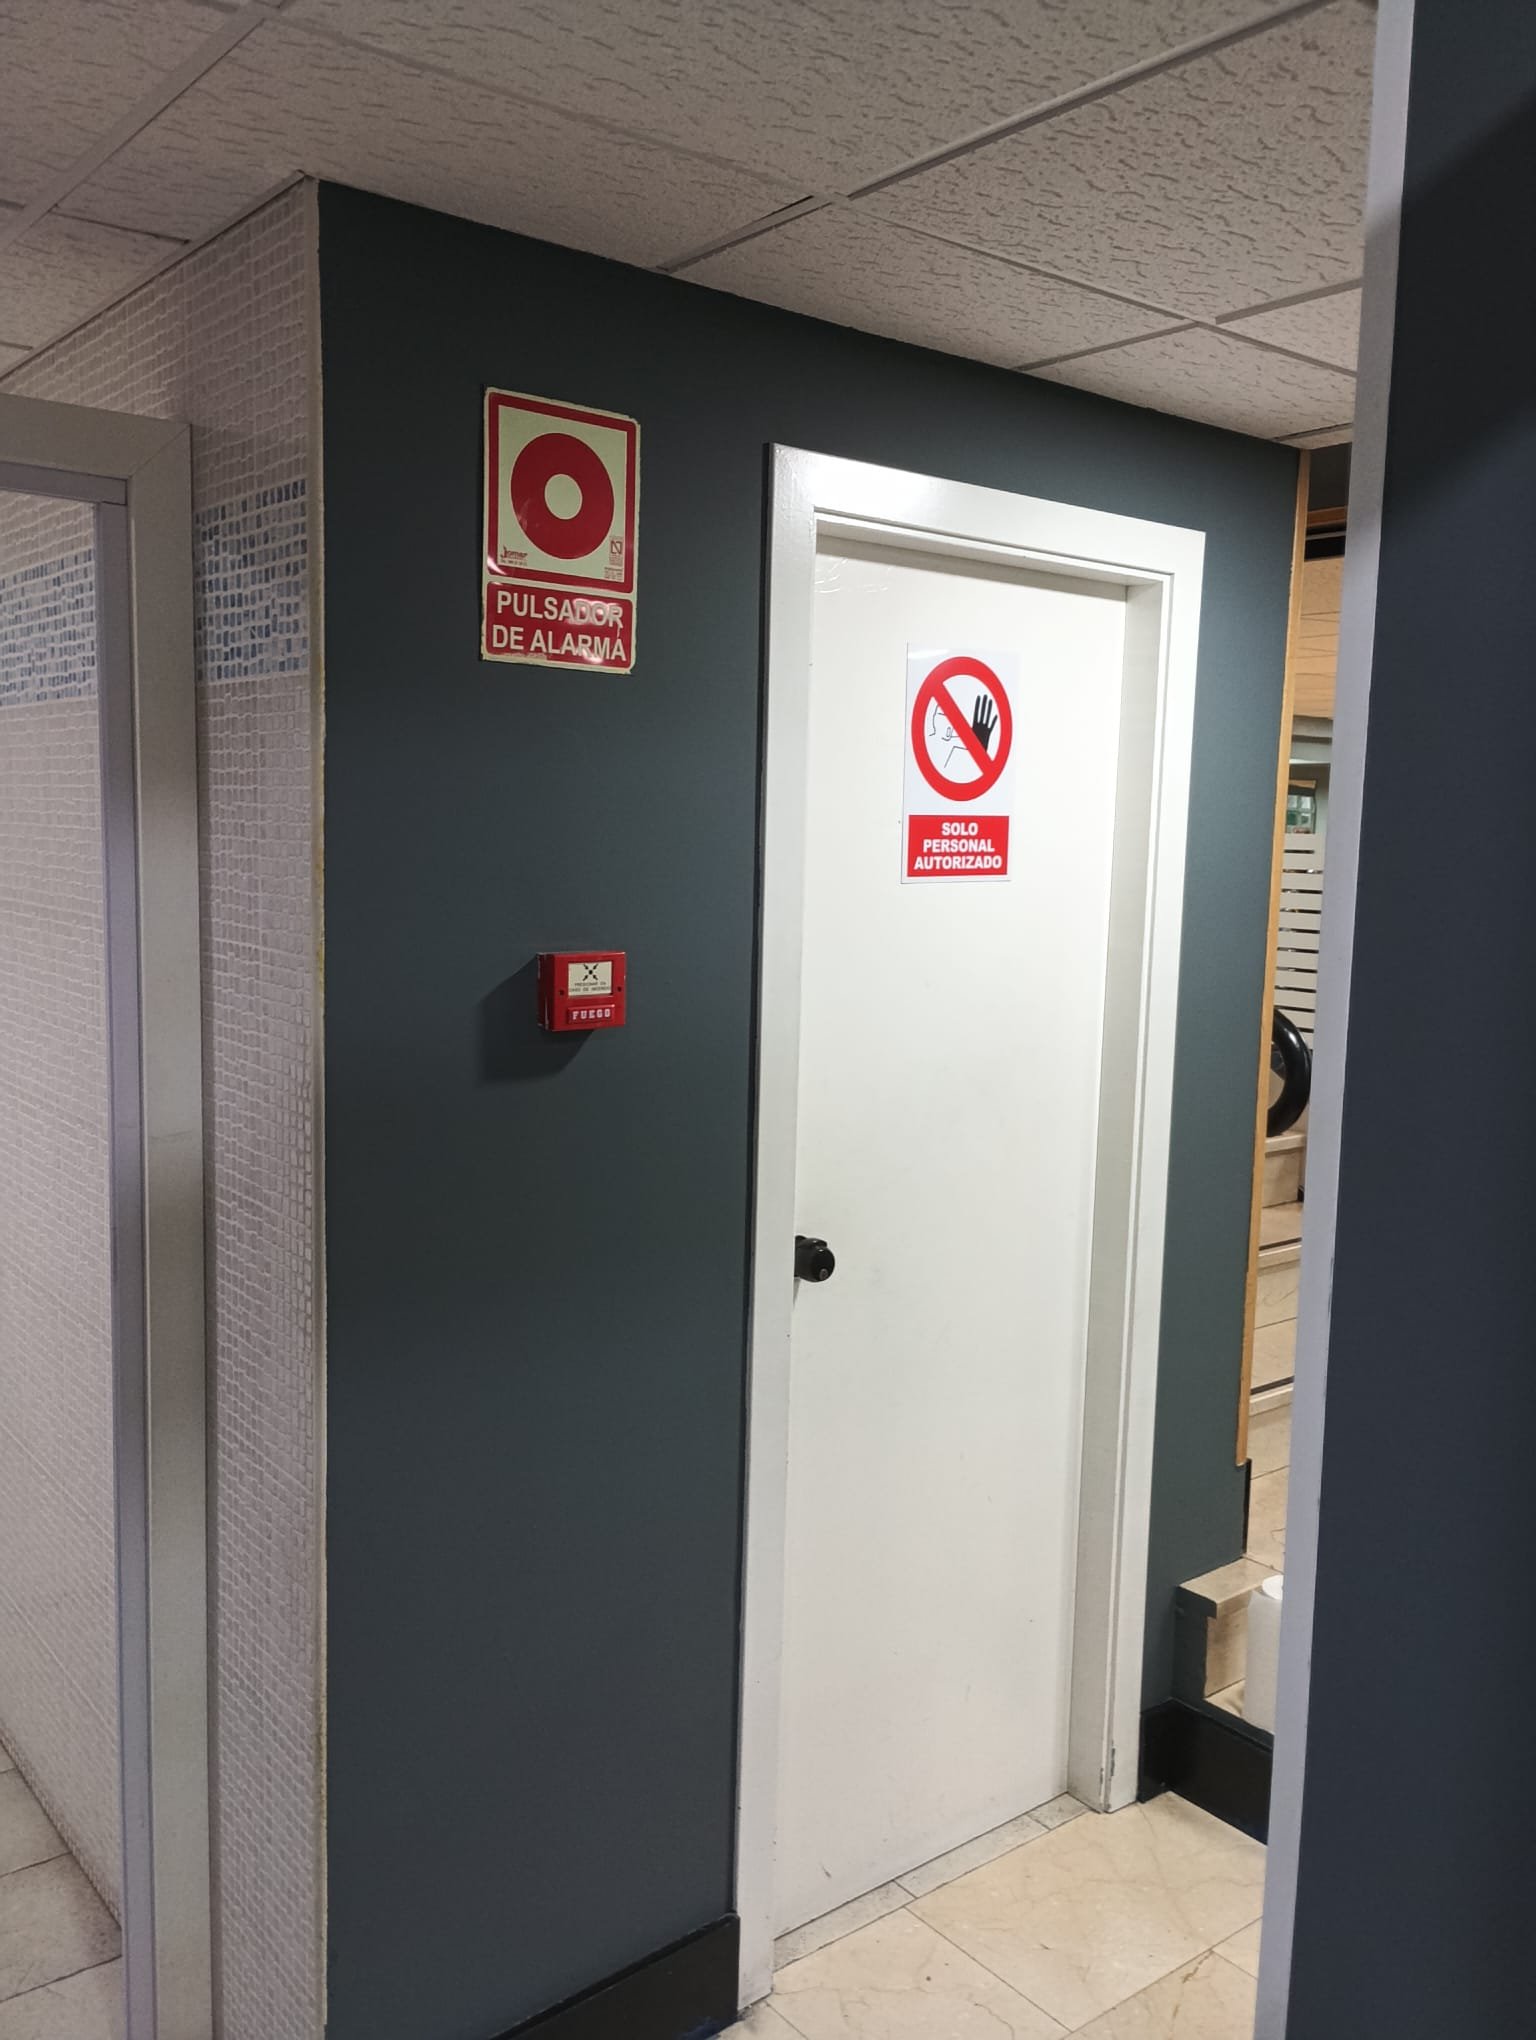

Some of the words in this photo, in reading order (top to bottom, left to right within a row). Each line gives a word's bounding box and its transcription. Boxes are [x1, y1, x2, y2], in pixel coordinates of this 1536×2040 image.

[497, 591, 623, 629] PULSADOR
[492, 624, 524, 650] DE
[530, 629, 627, 661] ALARMA
[941, 822, 979, 836] SOLO
[922, 839, 996, 853] PERSONAL
[913, 855, 1002, 870] AUTORIZADO
[572, 1008, 611, 1020] FUEGO
